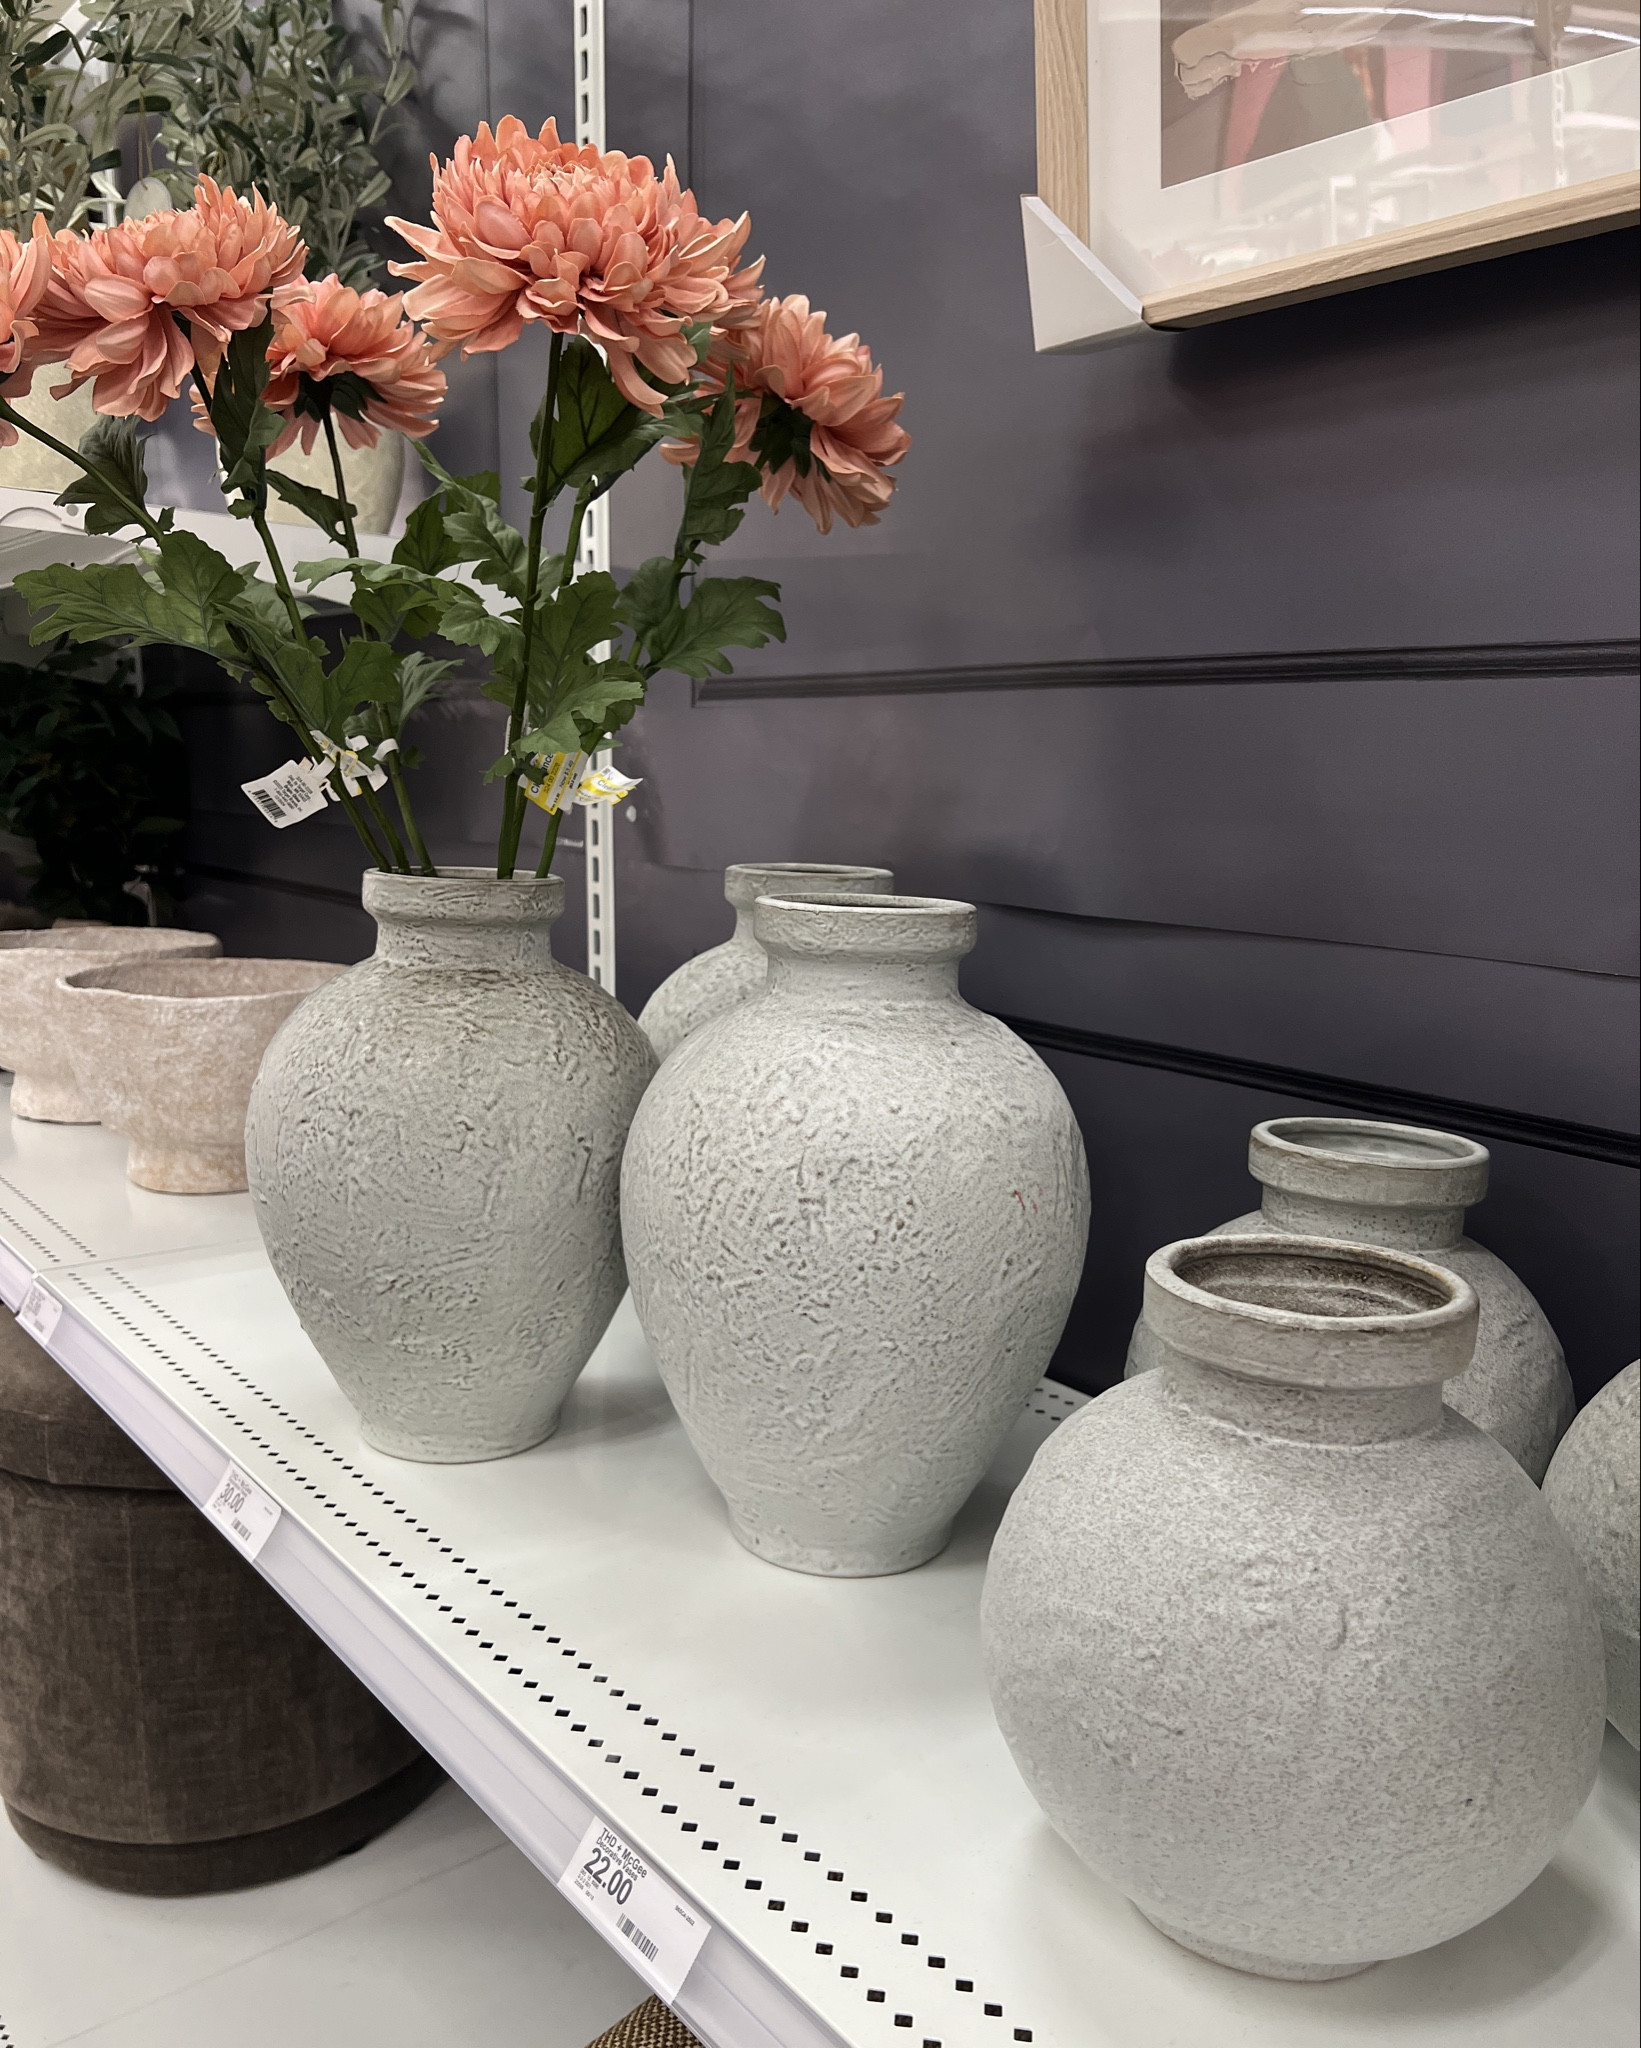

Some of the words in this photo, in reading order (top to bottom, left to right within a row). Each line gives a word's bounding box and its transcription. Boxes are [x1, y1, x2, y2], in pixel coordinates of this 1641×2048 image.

[220, 1483, 244, 1513] 30.00
[584, 1848, 632, 1905] 22.00
[596, 1837, 622, 1866] Decorative
[621, 1861, 638, 1881] Vases
[599, 1827, 618, 1849] THD
[621, 1848, 648, 1879] McGee
